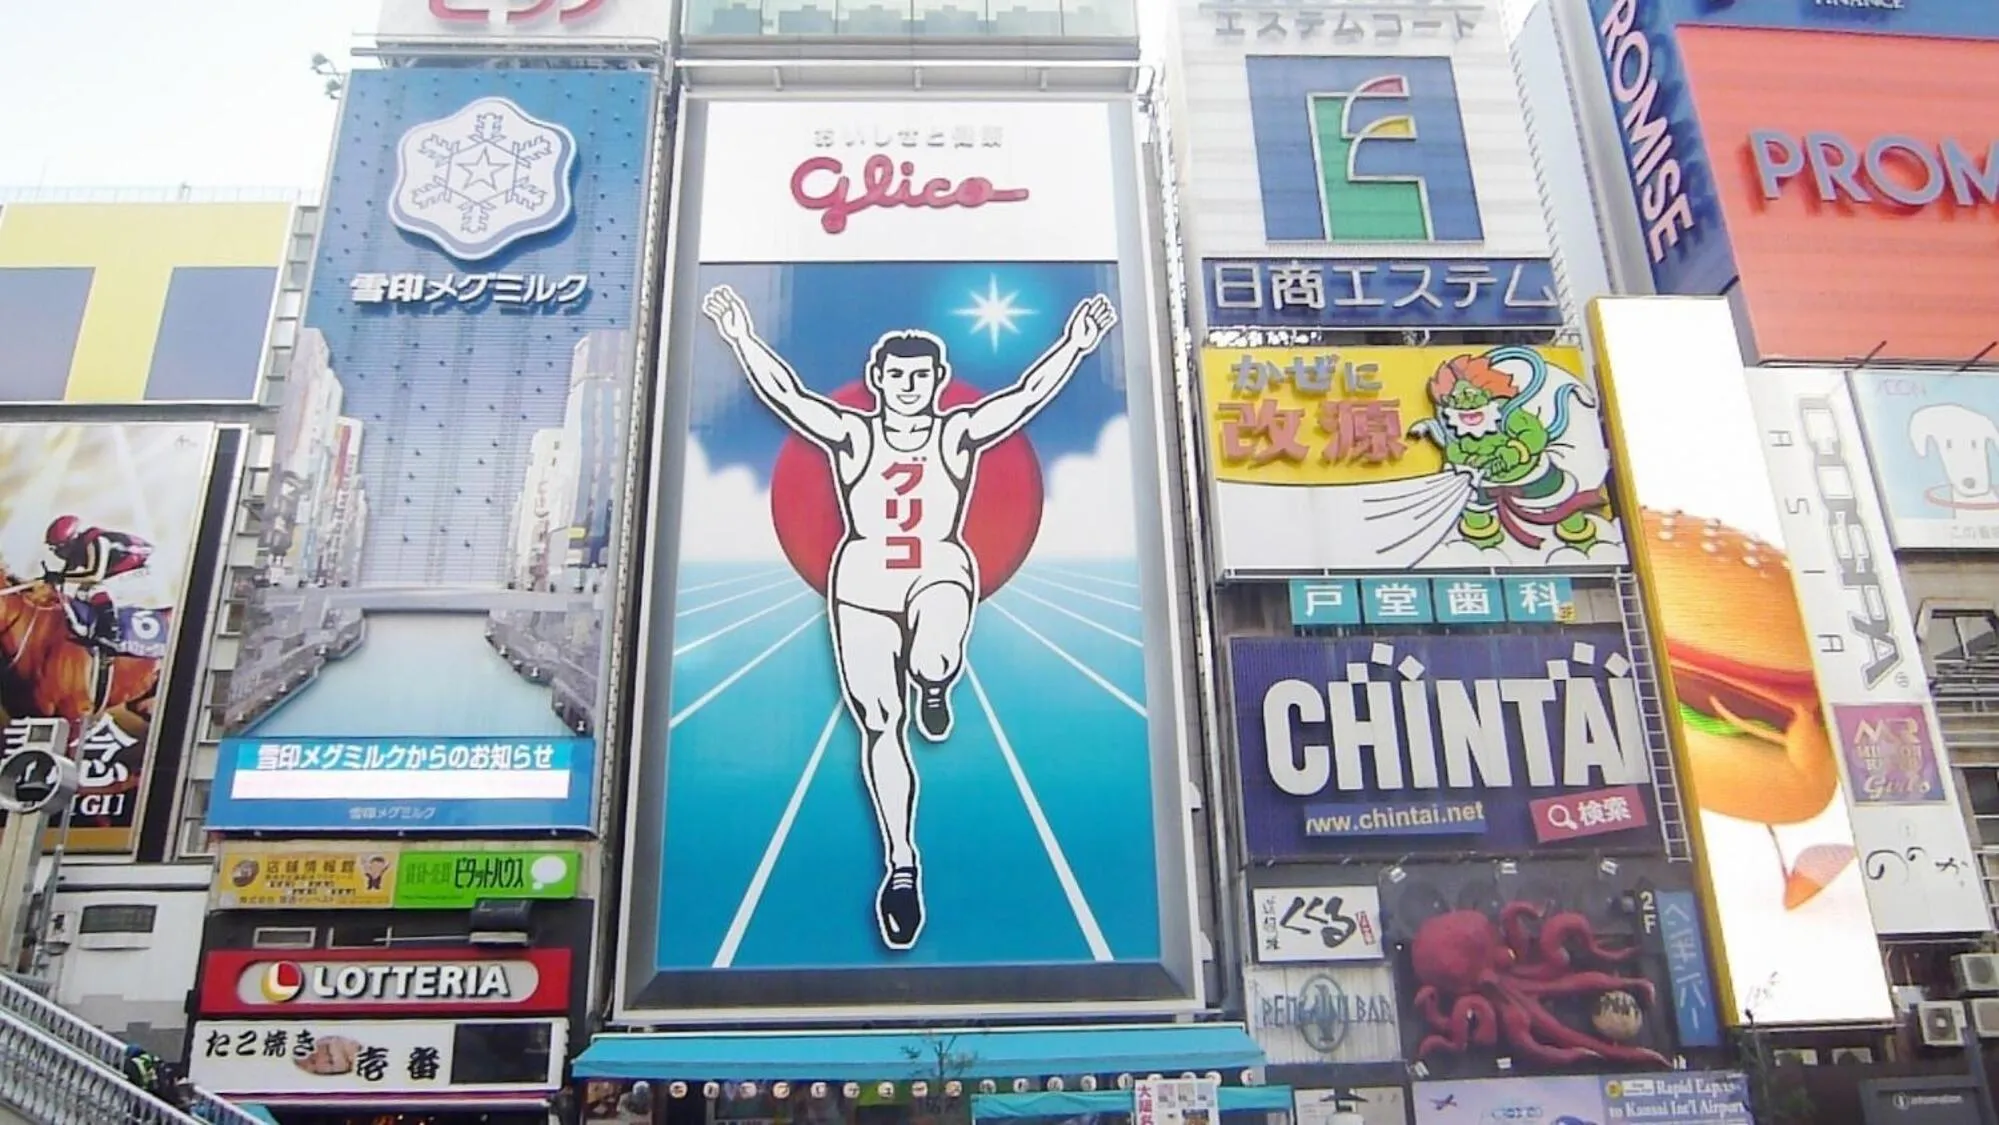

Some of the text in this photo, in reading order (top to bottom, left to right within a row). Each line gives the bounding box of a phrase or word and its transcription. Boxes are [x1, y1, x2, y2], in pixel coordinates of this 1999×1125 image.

[1215, 9, 1476, 42] エステムコート
[350, 272, 589, 305] 雪印メグミルク
[1213, 260, 1558, 310] 日商エステム
[1230, 353, 1384, 397] かぜに
[1217, 398, 1408, 469] 改源
[881, 456, 927, 569] グリコ
[1304, 582, 1560, 619] 戸堂歯科
[131, 610, 160, 640] 6
[1263, 643, 1651, 797] CHINTAI
[256, 743, 555, 771] 雪印メグミルクからのお知らせ
[348, 806, 437, 821] 雪印メグミルク
[1578, 798, 1631, 828] 検索
[1640, 891, 1656, 934] 2F
[312, 966, 510, 999] LOTTERIA
[206, 1030, 441, 1083] たこ焼き 壱番
[1655, 1078, 1692, 1098] Rapid
[1609, 1106, 1624, 1119] to
[1625, 1101, 1668, 1118] Kansai
[1699, 1101, 1745, 1119] Airport
